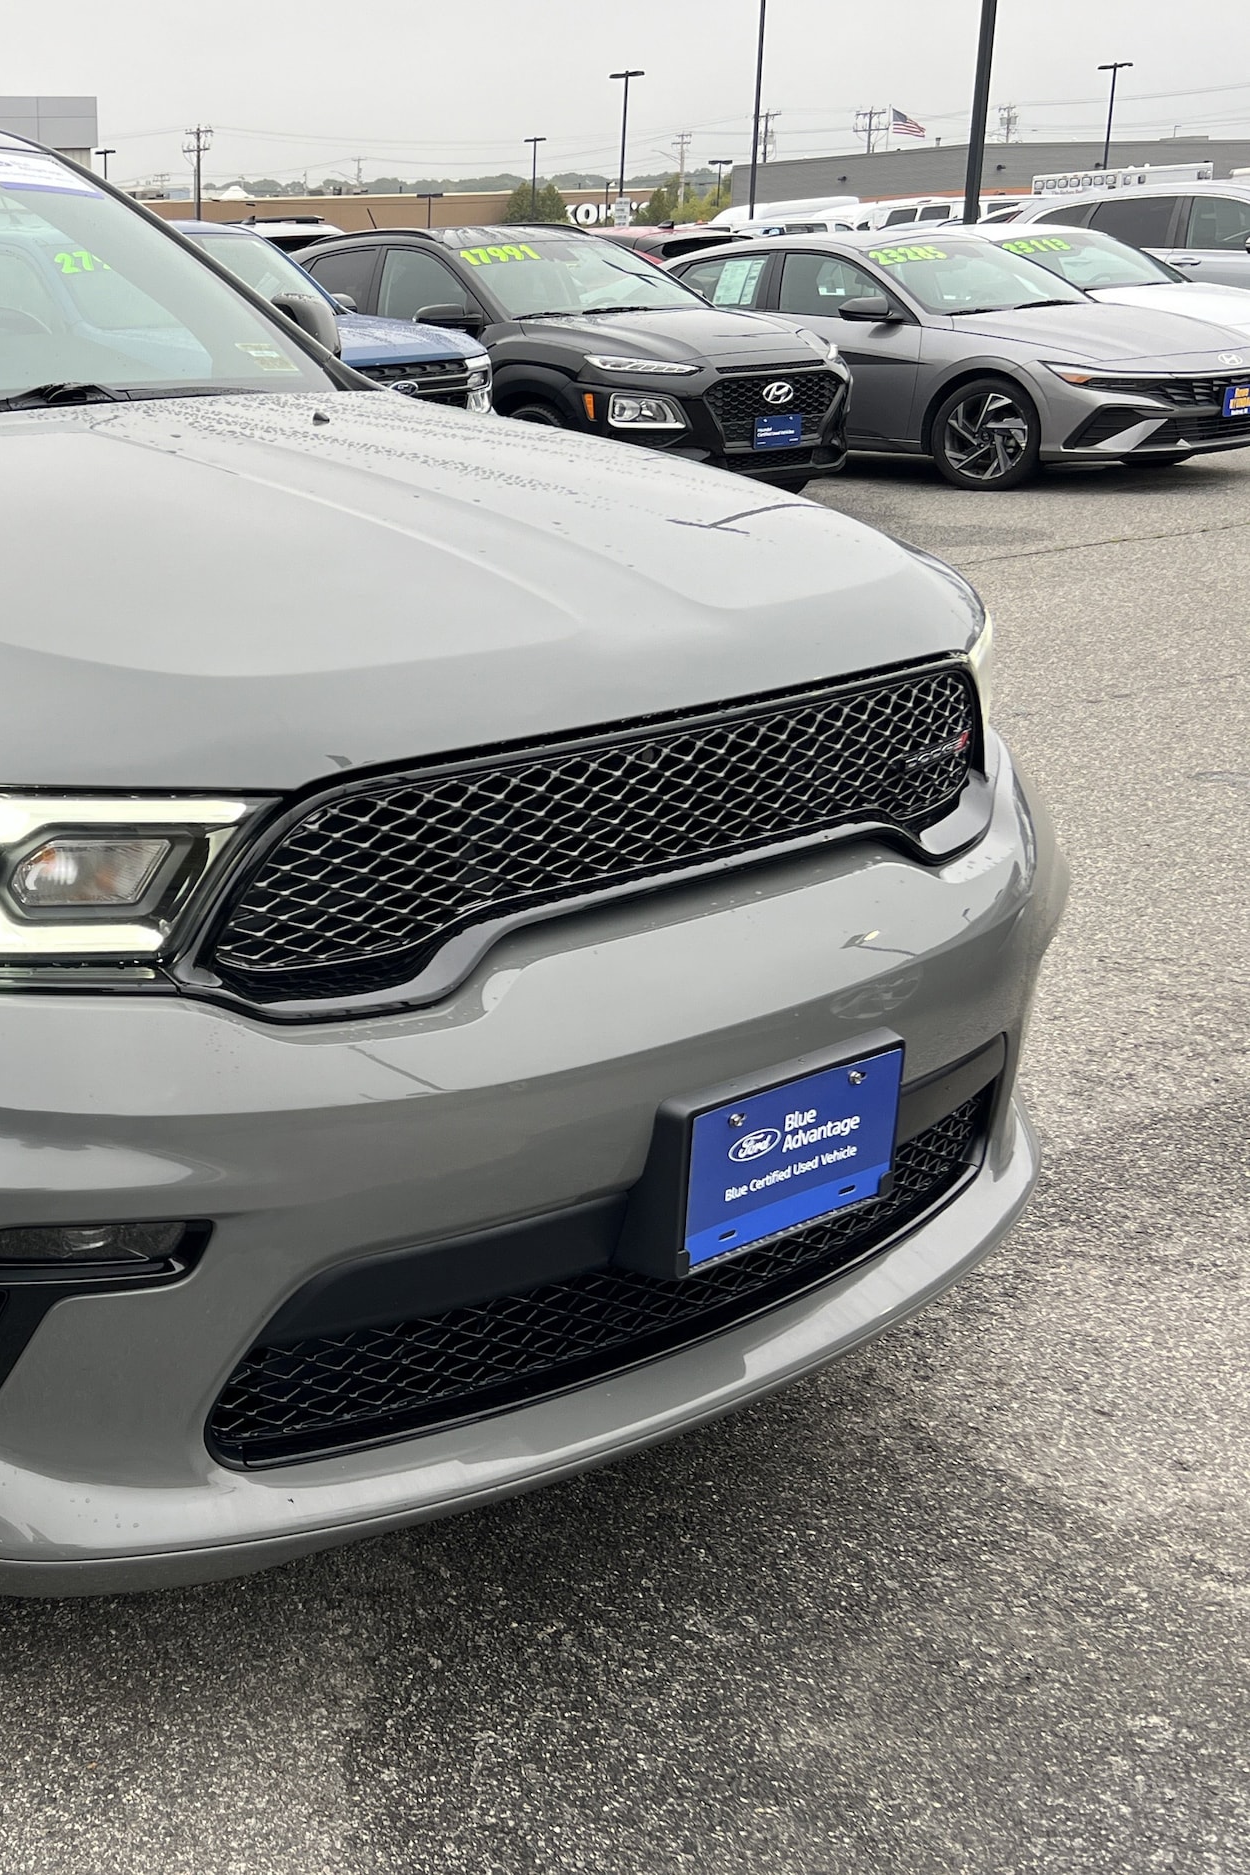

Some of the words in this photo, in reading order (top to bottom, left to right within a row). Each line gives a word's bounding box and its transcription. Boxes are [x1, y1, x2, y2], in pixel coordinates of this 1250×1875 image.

[460, 243, 541, 266] 17991
[868, 245, 948, 266] 23285
[1001, 238, 1071, 255] 23113
[784, 1109, 817, 1132] Blue
[736, 1132, 774, 1159] Ford
[782, 1115, 861, 1153] Advantage
[724, 1184, 748, 1202] Blue
[749, 1166, 792, 1192] Certified
[793, 1156, 819, 1176] Used
[821, 1145, 858, 1166] Vehicle
